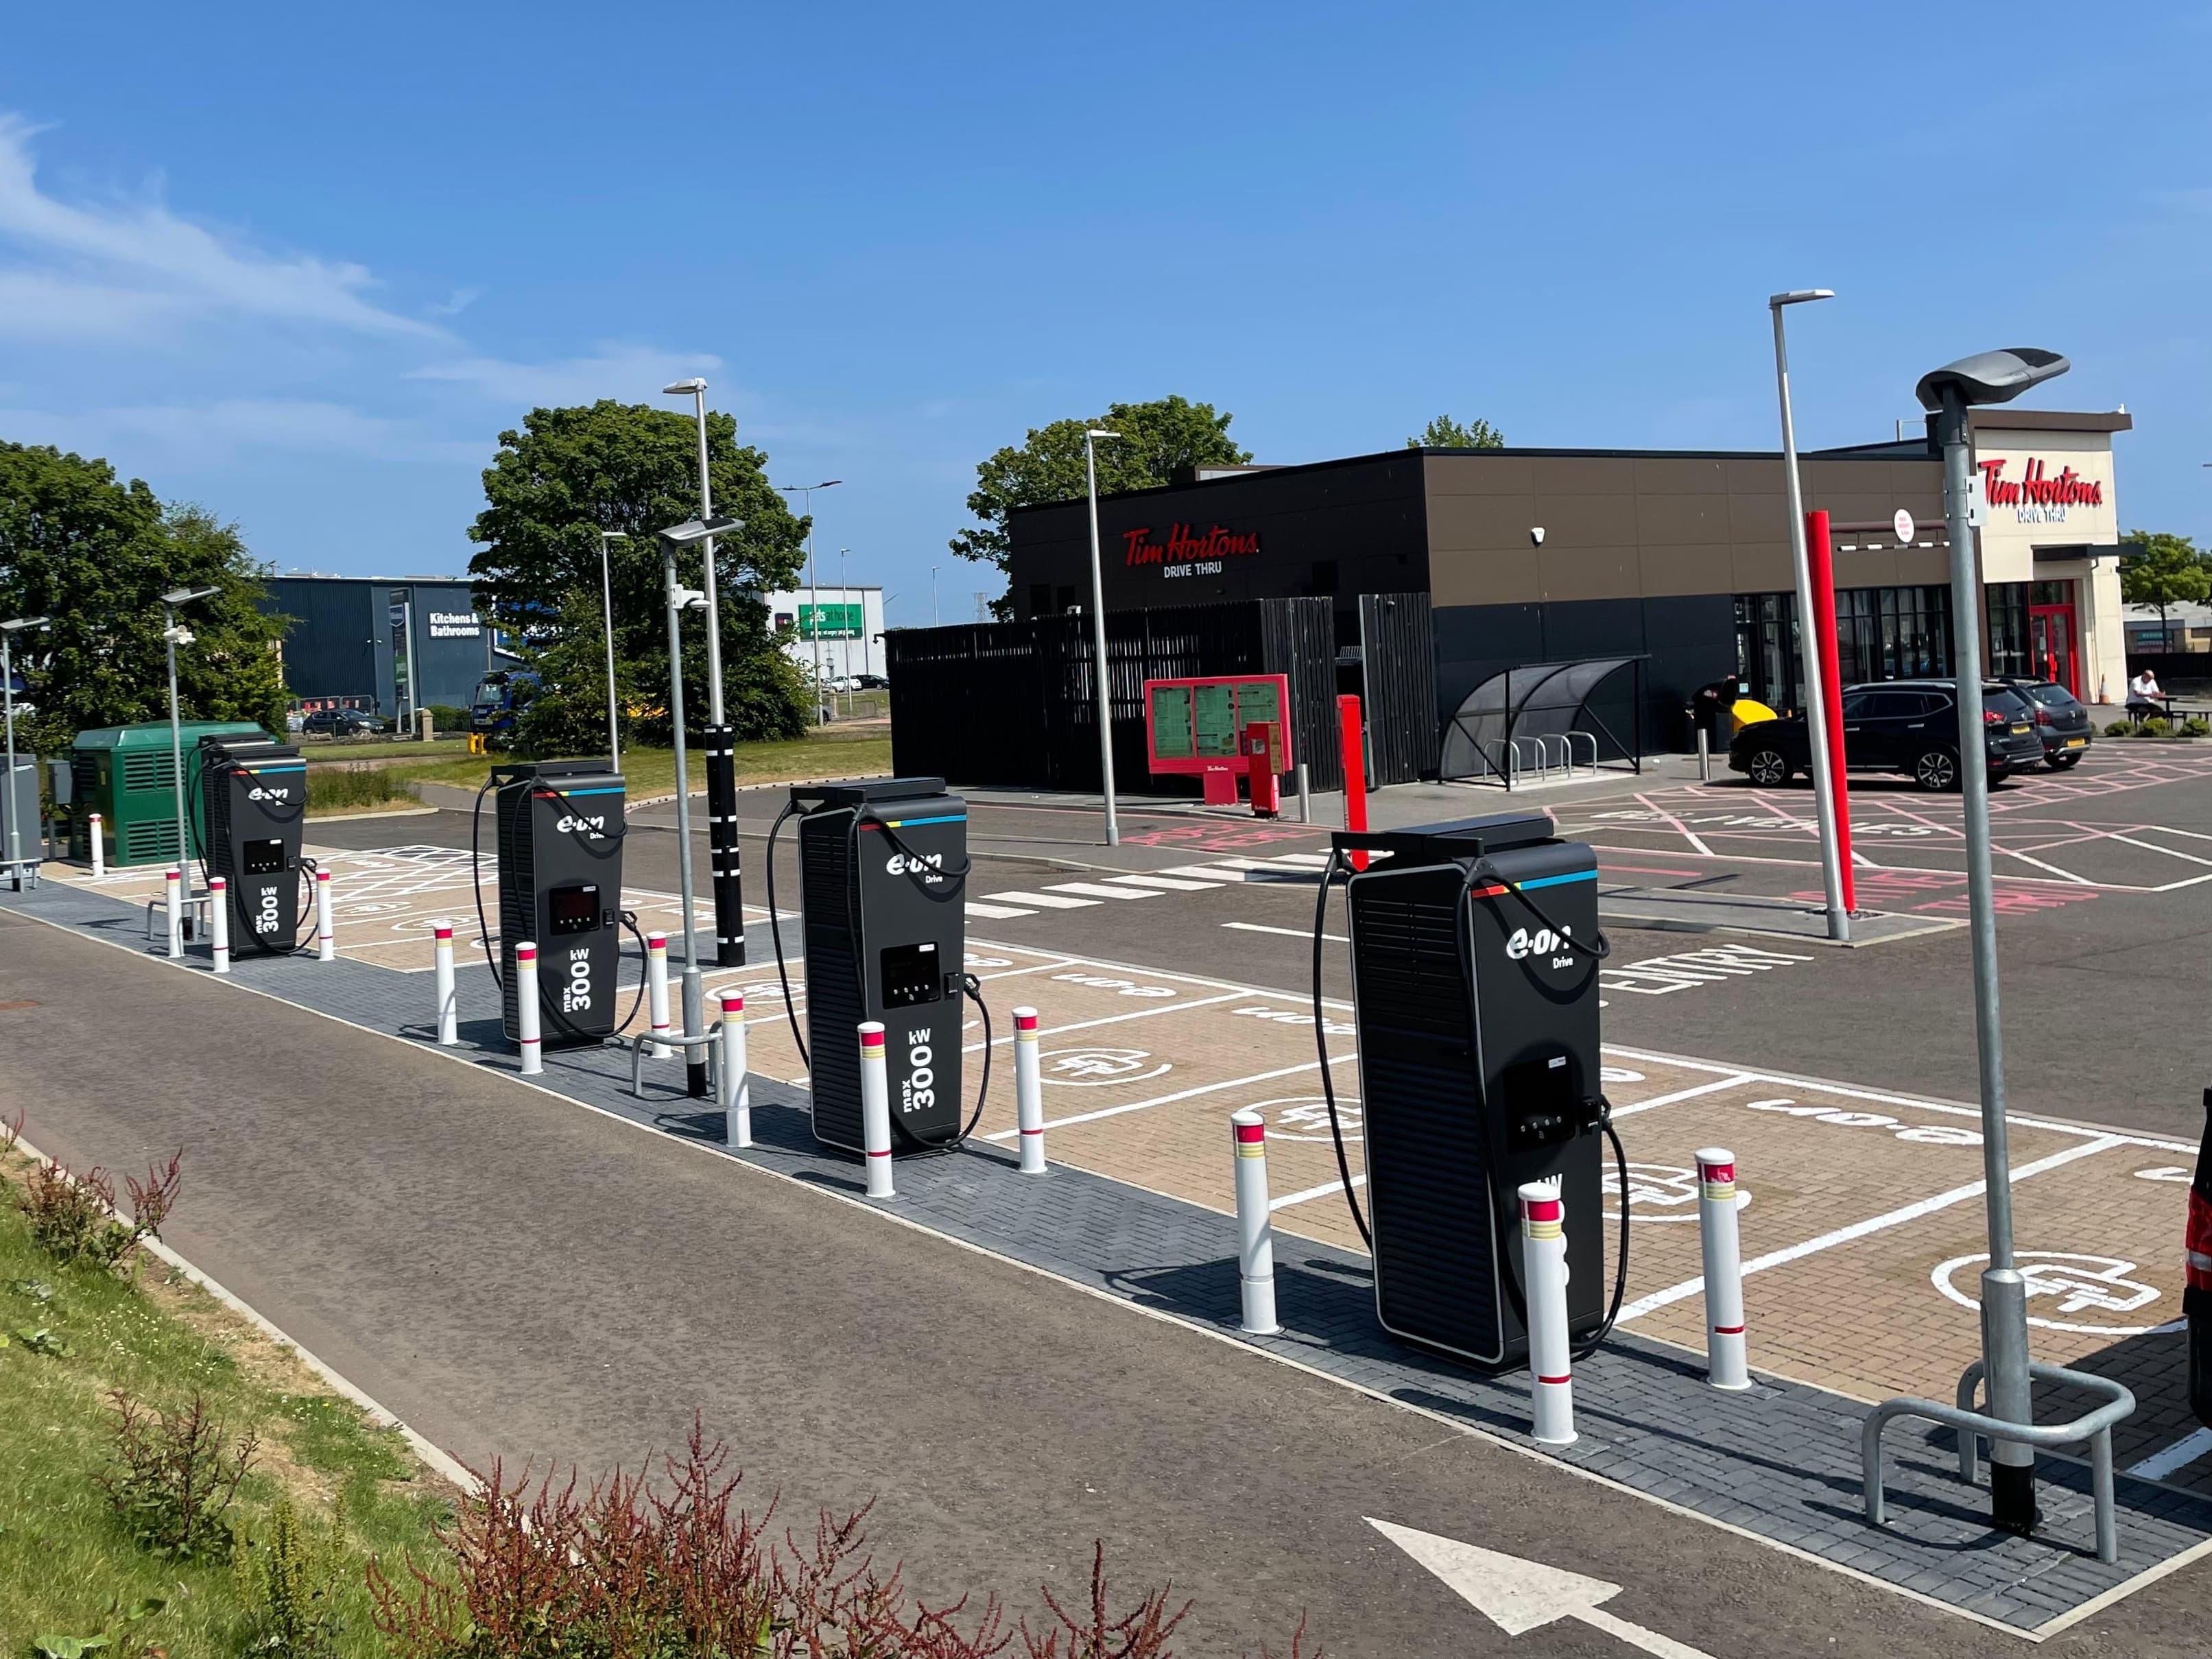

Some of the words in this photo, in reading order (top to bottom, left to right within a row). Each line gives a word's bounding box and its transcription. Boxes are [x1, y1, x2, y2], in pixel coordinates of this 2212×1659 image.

[1977, 459, 2021, 505] Tim
[2021, 457, 2103, 505] Hortons
[2018, 508, 2043, 523] DRIVE
[2045, 508, 2067, 523] THRU
[1123, 528, 1163, 566] Tim
[1166, 523, 1259, 562] Hortons
[1164, 564, 1192, 579] DRIVE
[1195, 560, 1222, 575] THRU
[429, 612, 471, 624] Kitchens
[471, 612, 479, 623] &
[430, 625, 480, 636] Bathrooms
[925, 874, 943, 884] Drive
[261, 886, 278, 896] kW
[261, 896, 279, 933] 300
[570, 948, 590, 961] kW
[1553, 956, 1573, 969] Drive
[571, 961, 591, 1011] 300
[563, 986, 571, 1012] max
[908, 1028, 931, 1046] kW
[910, 1045, 936, 1110] 300
[902, 1079, 912, 1113] max
